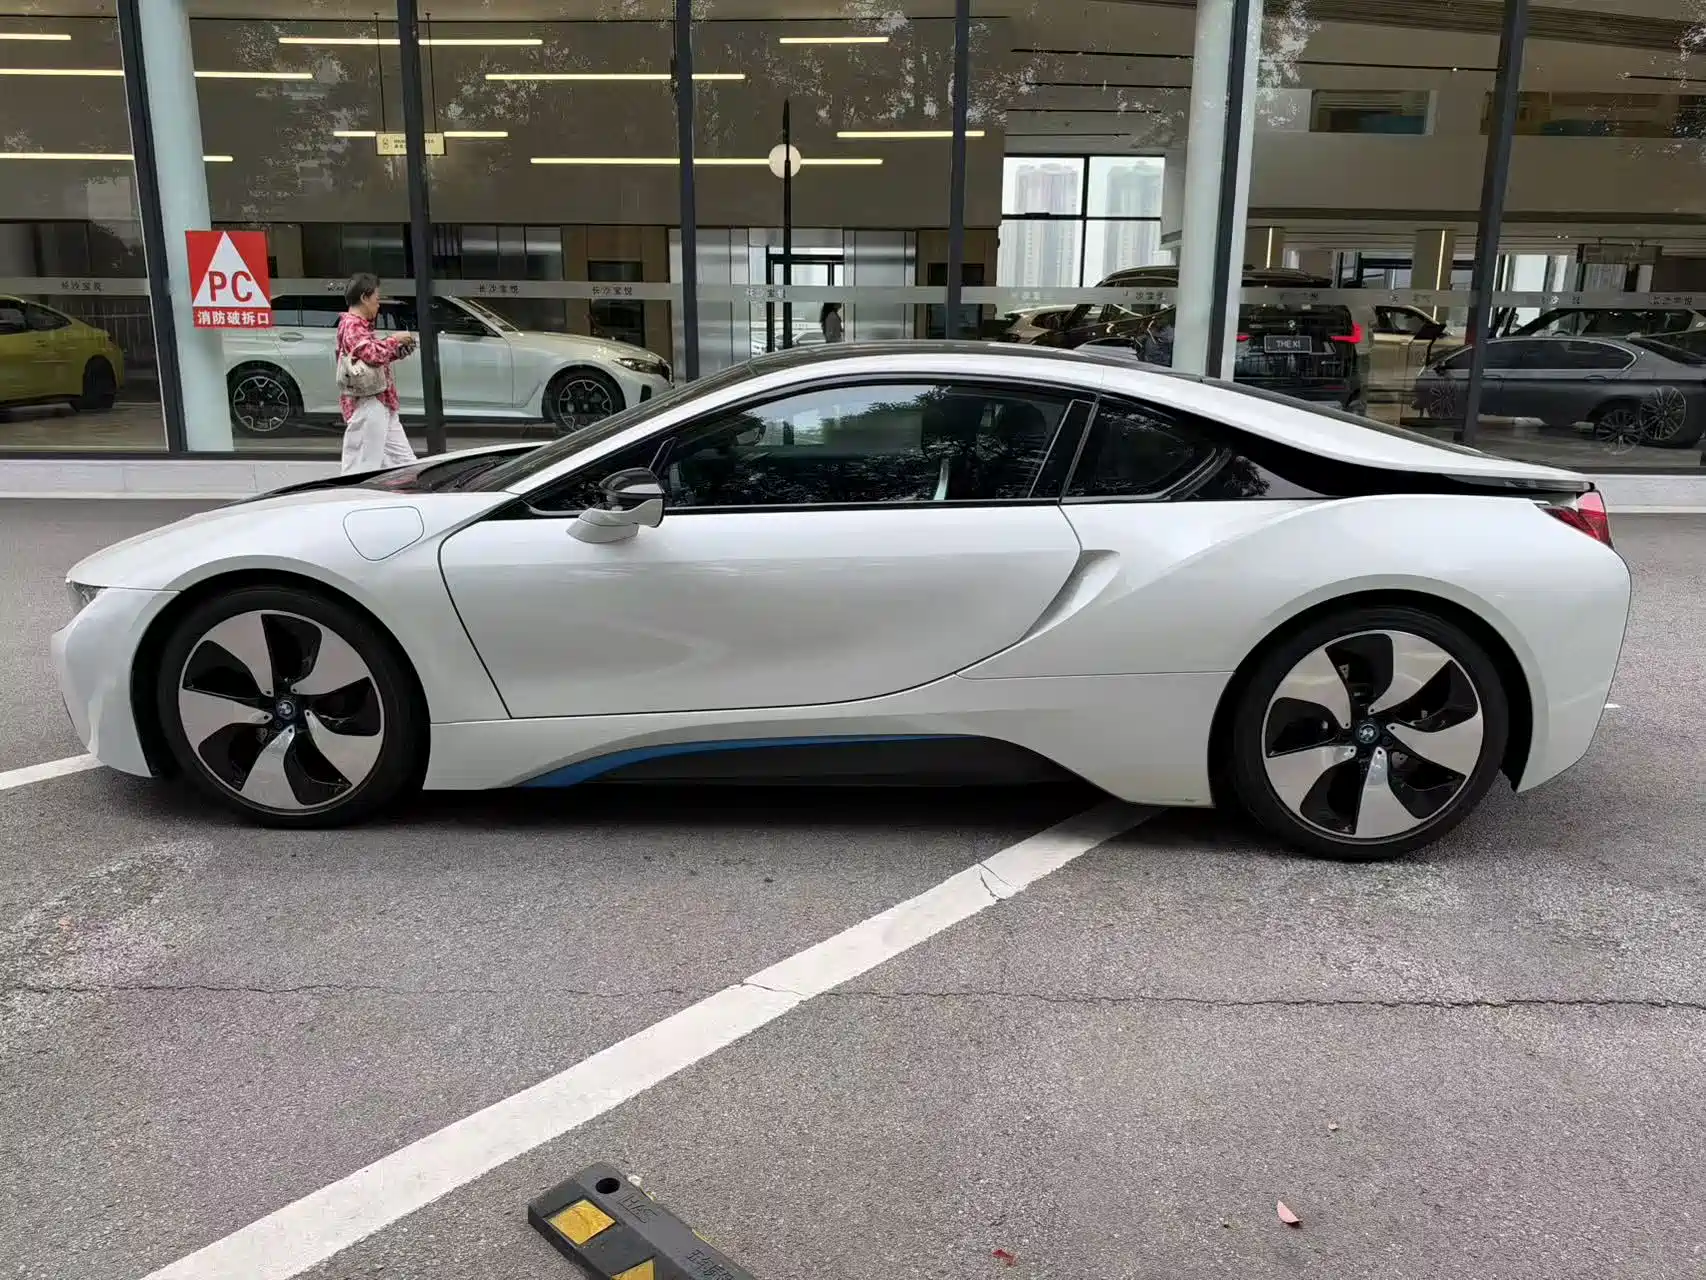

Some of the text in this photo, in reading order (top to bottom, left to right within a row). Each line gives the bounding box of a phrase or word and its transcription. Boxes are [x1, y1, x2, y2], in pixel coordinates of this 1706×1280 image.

[208, 270, 253, 302] PC
[198, 310, 269, 325] 消防破拆口
[1276, 339, 1291, 349] THE
